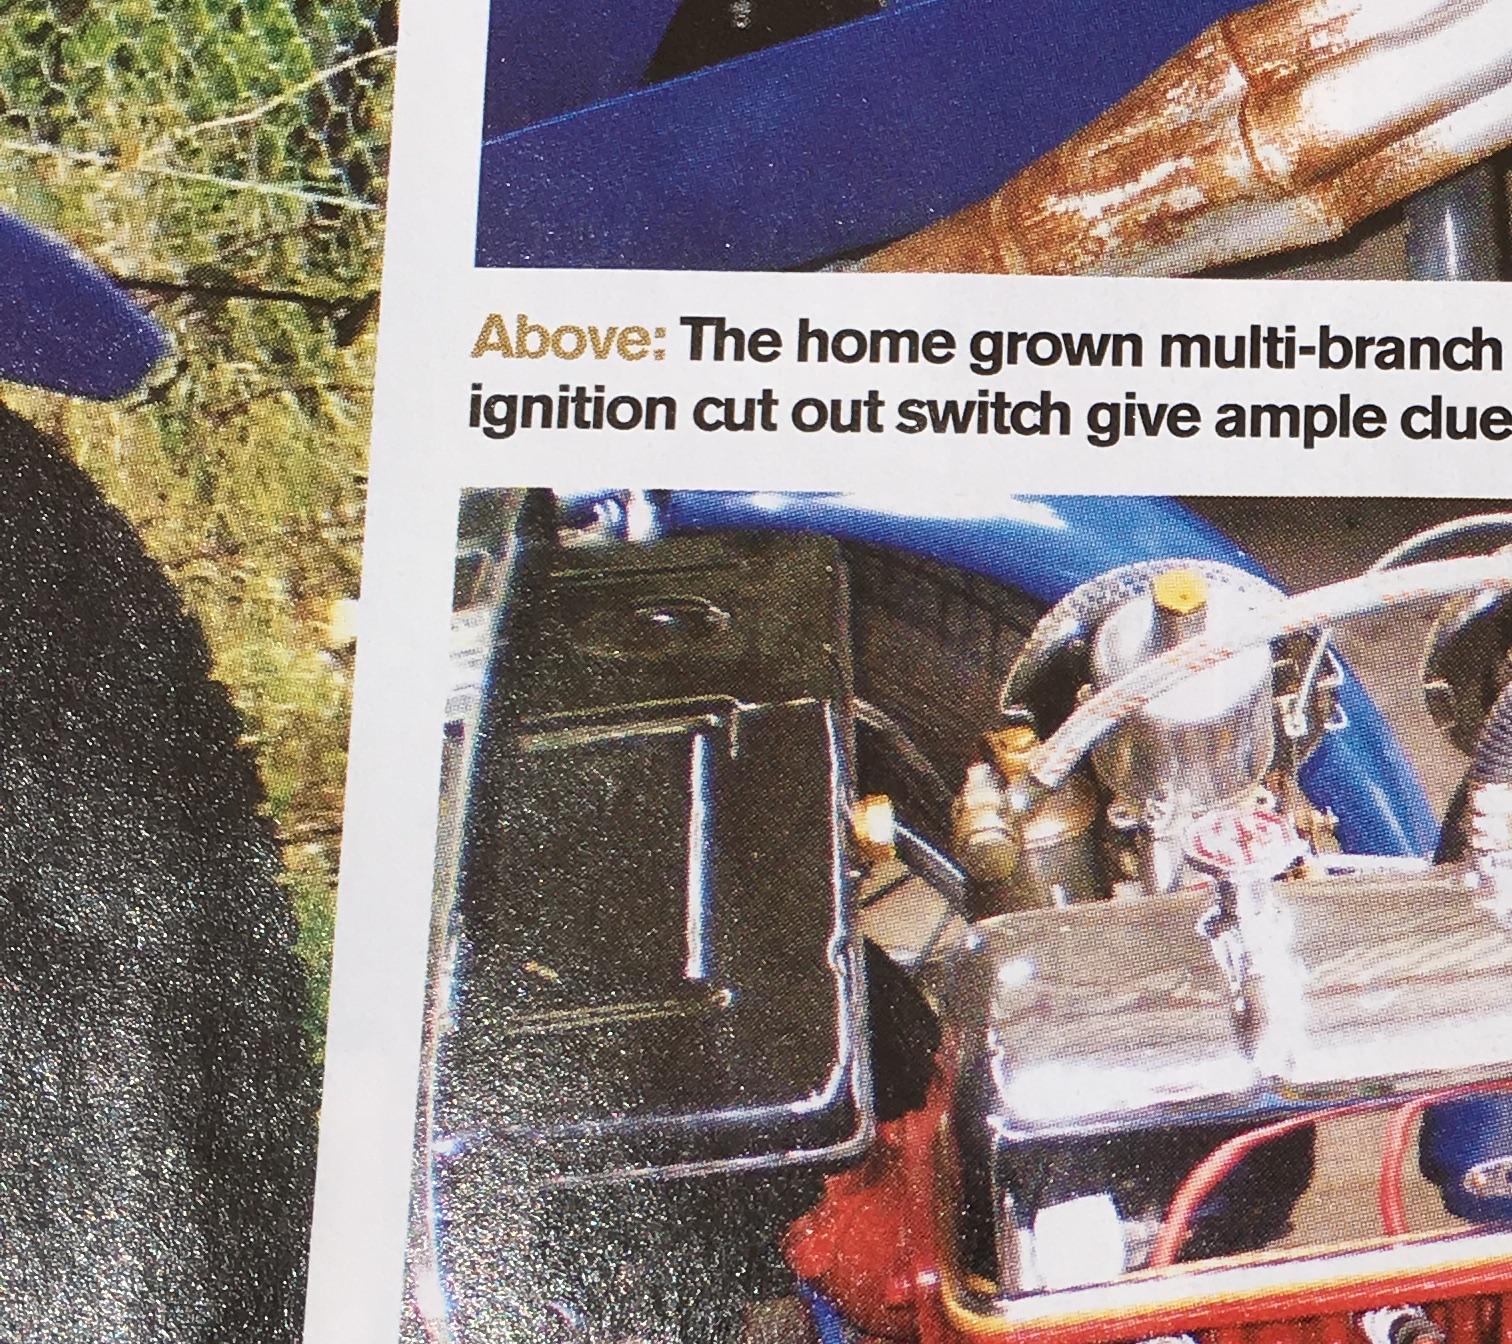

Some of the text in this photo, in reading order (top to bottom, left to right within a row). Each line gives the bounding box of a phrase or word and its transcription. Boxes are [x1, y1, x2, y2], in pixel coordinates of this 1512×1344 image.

[470, 311, 667, 361] Above:
[680, 316, 783, 363] The
[797, 318, 956, 364] home
[969, 329, 1143, 376] grown
[1160, 324, 1502, 372] multi-branch
[468, 383, 677, 439] ignition
[692, 389, 779, 432] cut
[790, 389, 884, 434] out
[895, 391, 1072, 436] switch
[1086, 392, 1201, 447] give
[1214, 393, 1387, 449] ample
